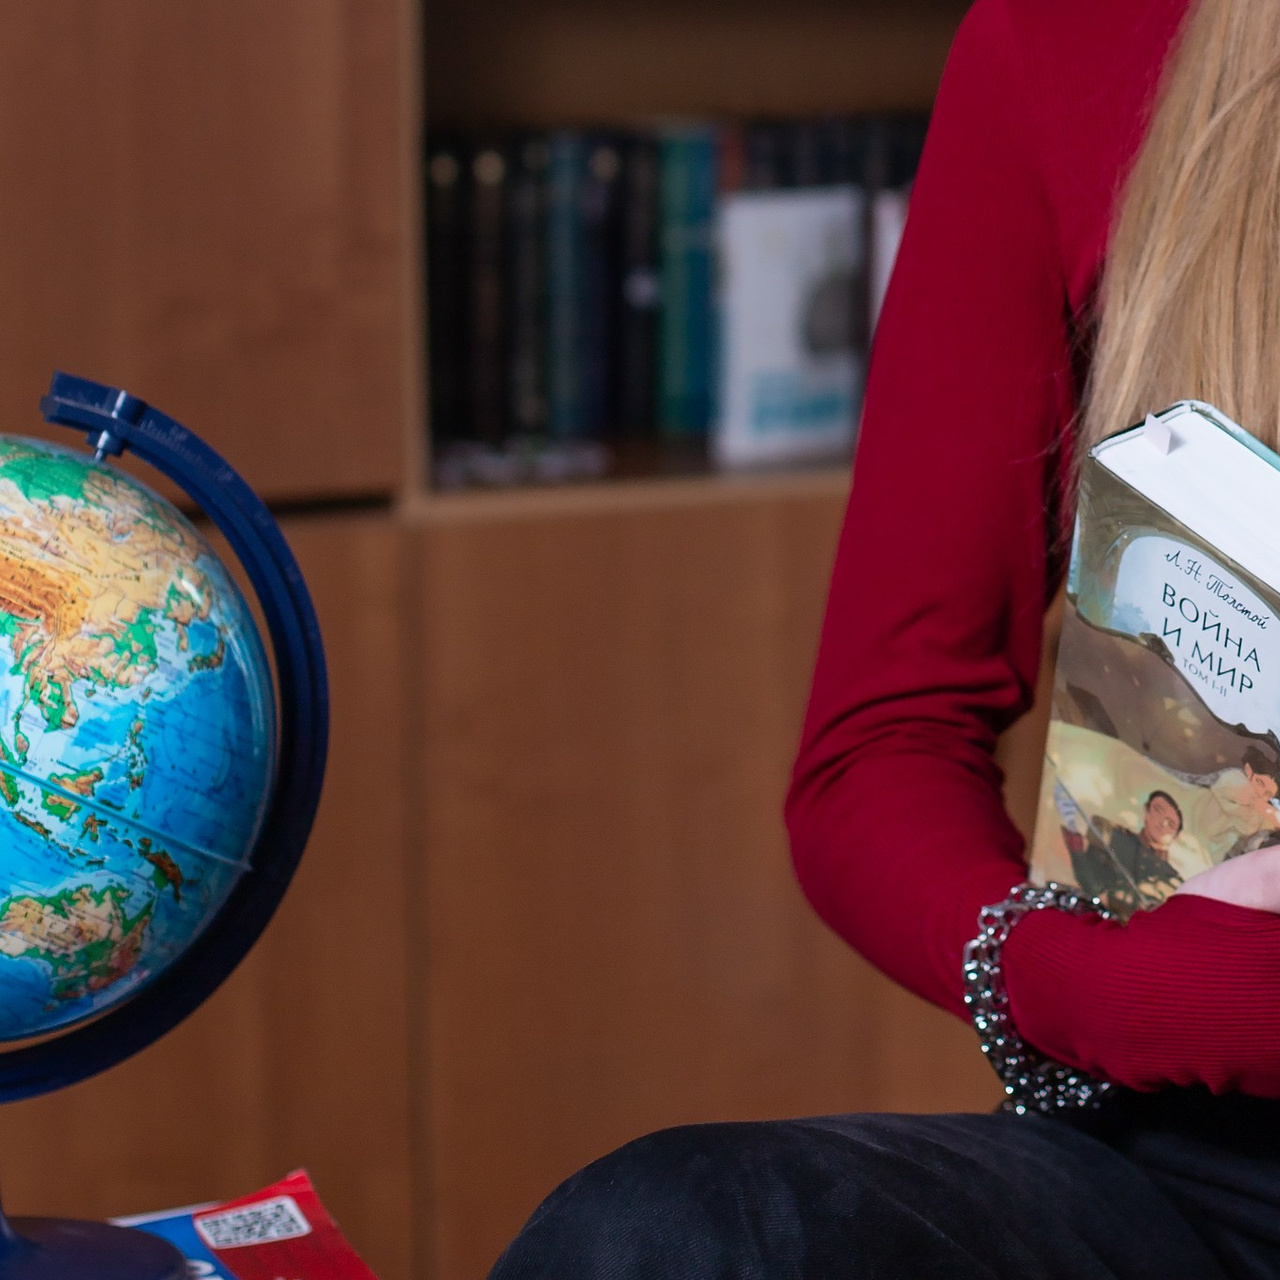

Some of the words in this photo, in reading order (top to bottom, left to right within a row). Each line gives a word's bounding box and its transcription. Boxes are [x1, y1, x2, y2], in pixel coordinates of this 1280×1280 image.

[1162, 582, 1262, 673] ВОЙНА
[1206, 574, 1272, 630] Толстой
[1162, 617, 1182, 648] И
[1191, 640, 1254, 694] МИР
[1182, 658, 1209, 685] ТОМ
